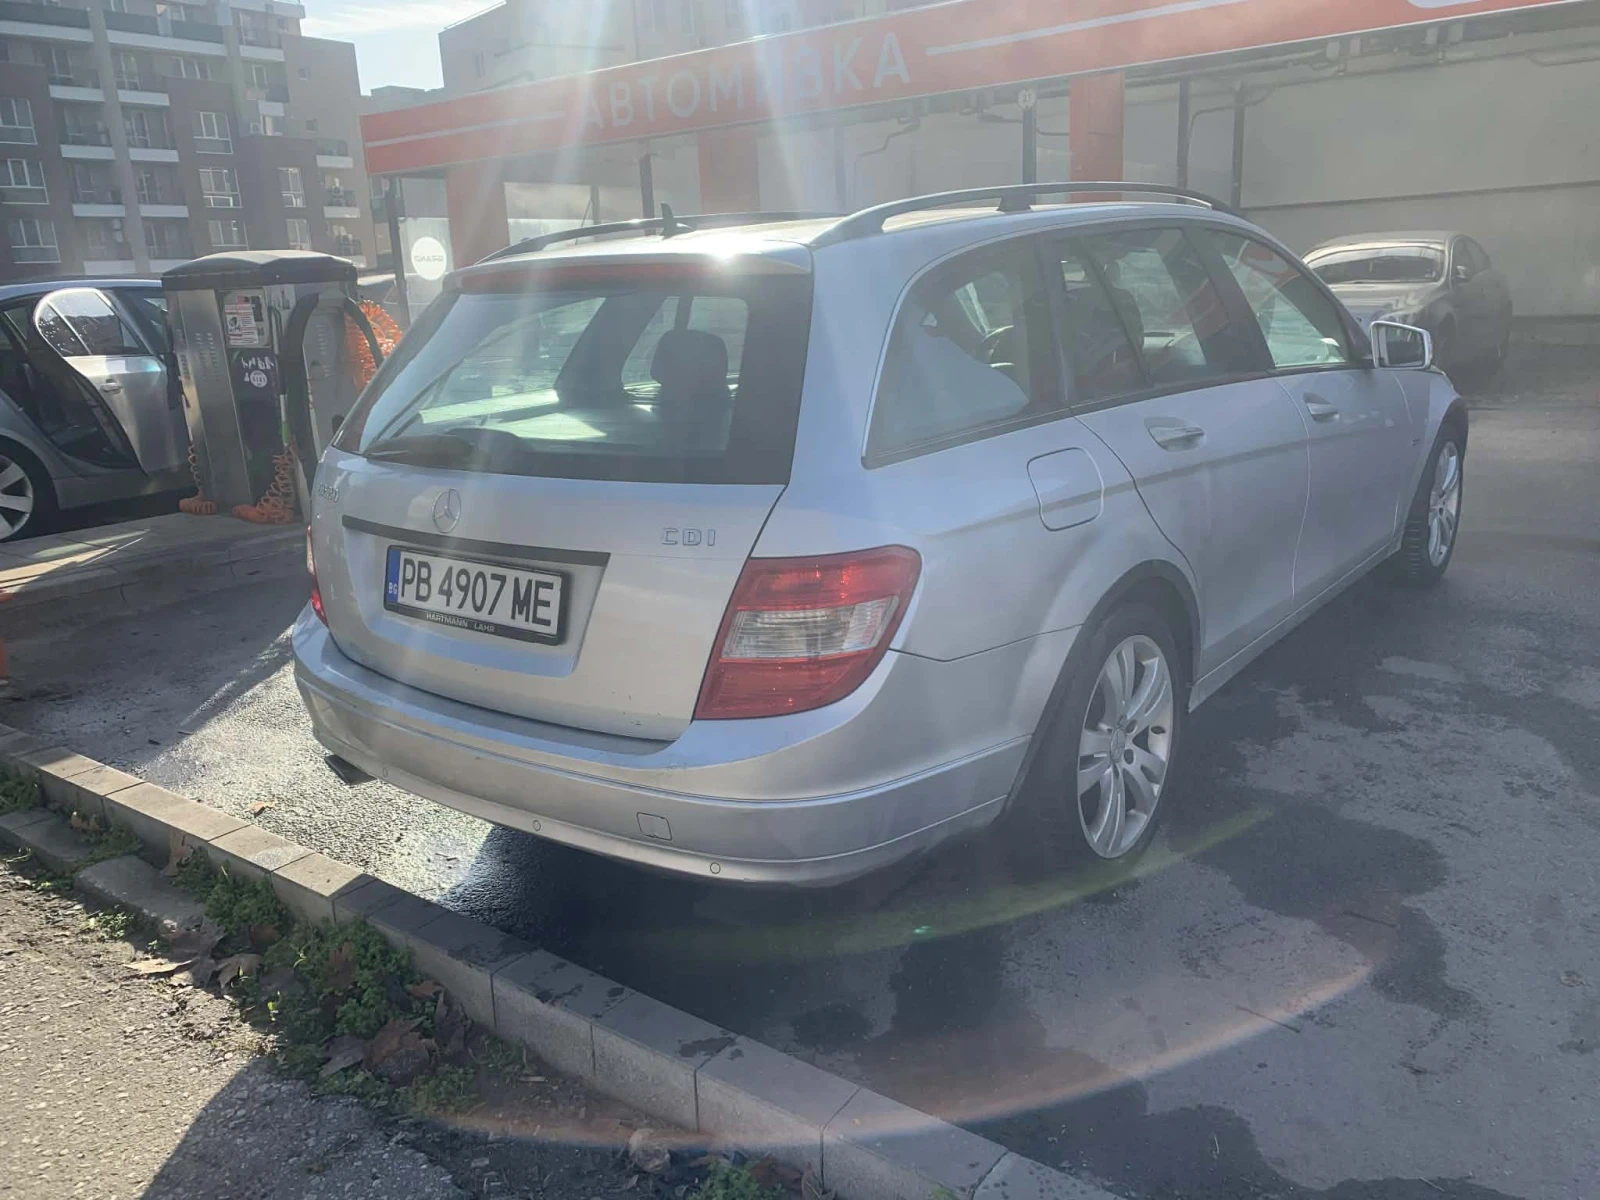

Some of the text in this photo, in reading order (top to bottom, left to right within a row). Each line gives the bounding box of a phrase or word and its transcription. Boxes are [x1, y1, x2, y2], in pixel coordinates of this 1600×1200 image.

[582, 32, 911, 129] АВТОМИВКА
[662, 527, 716, 547] CDI
[388, 582, 398, 595] BG
[401, 558, 554, 627] PB 4907 ME
[426, 612, 496, 634] HARTMANN LAHR
